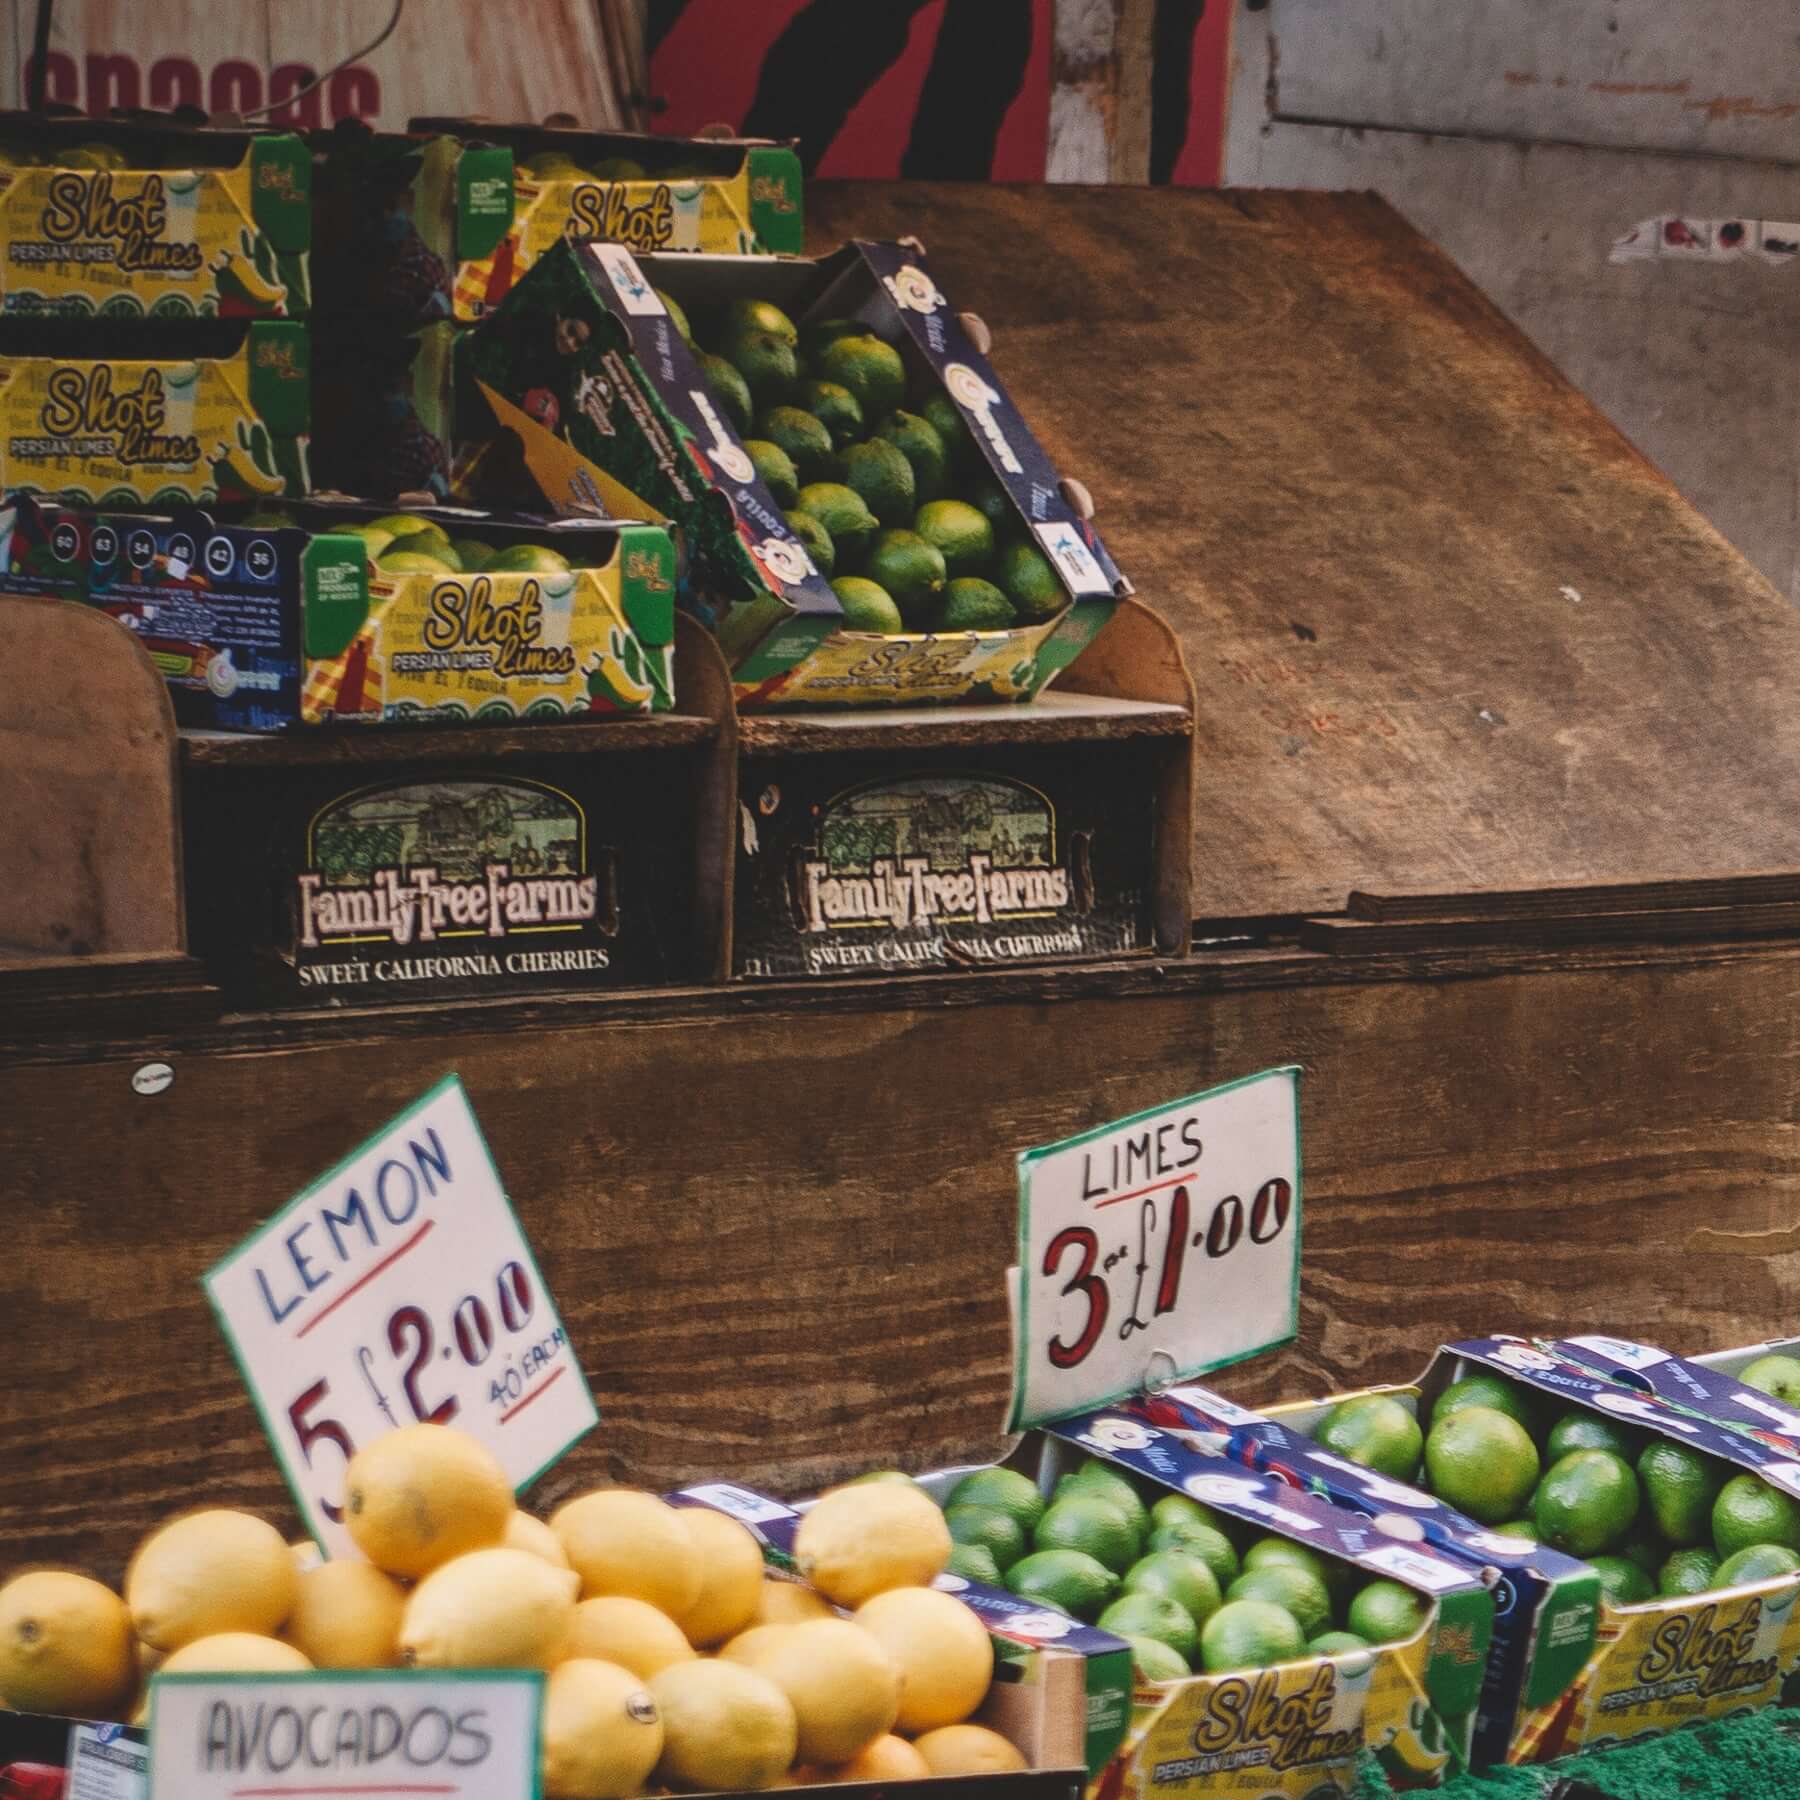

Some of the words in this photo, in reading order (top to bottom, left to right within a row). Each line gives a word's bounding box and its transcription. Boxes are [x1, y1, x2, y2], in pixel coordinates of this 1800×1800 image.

[41, 169, 167, 242] Shot
[566, 182, 675, 244] Shot
[41, 363, 166, 436] Shot
[424, 577, 542, 651] Shot
[393, 653, 451, 673] PERSIAN
[453, 652, 493, 671] LIMES
[297, 960, 371, 987] SWEET
[373, 953, 502, 984] CALIFORNIA
[504, 948, 611, 975] CHERRIES
[1082, 1117, 1204, 1201] LIMES
[255, 1126, 453, 1325] LEMON
[1042, 1226, 1110, 1369] 3
[287, 1376, 359, 1524] 5
[1637, 1597, 1762, 1684] Shot
[204, 1699, 493, 1774] AVOCADOS
[1194, 1661, 1337, 1755] Shot
[1153, 1754, 1222, 1784] PERSIAN
[1224, 1747, 1271, 1771] LIMES
